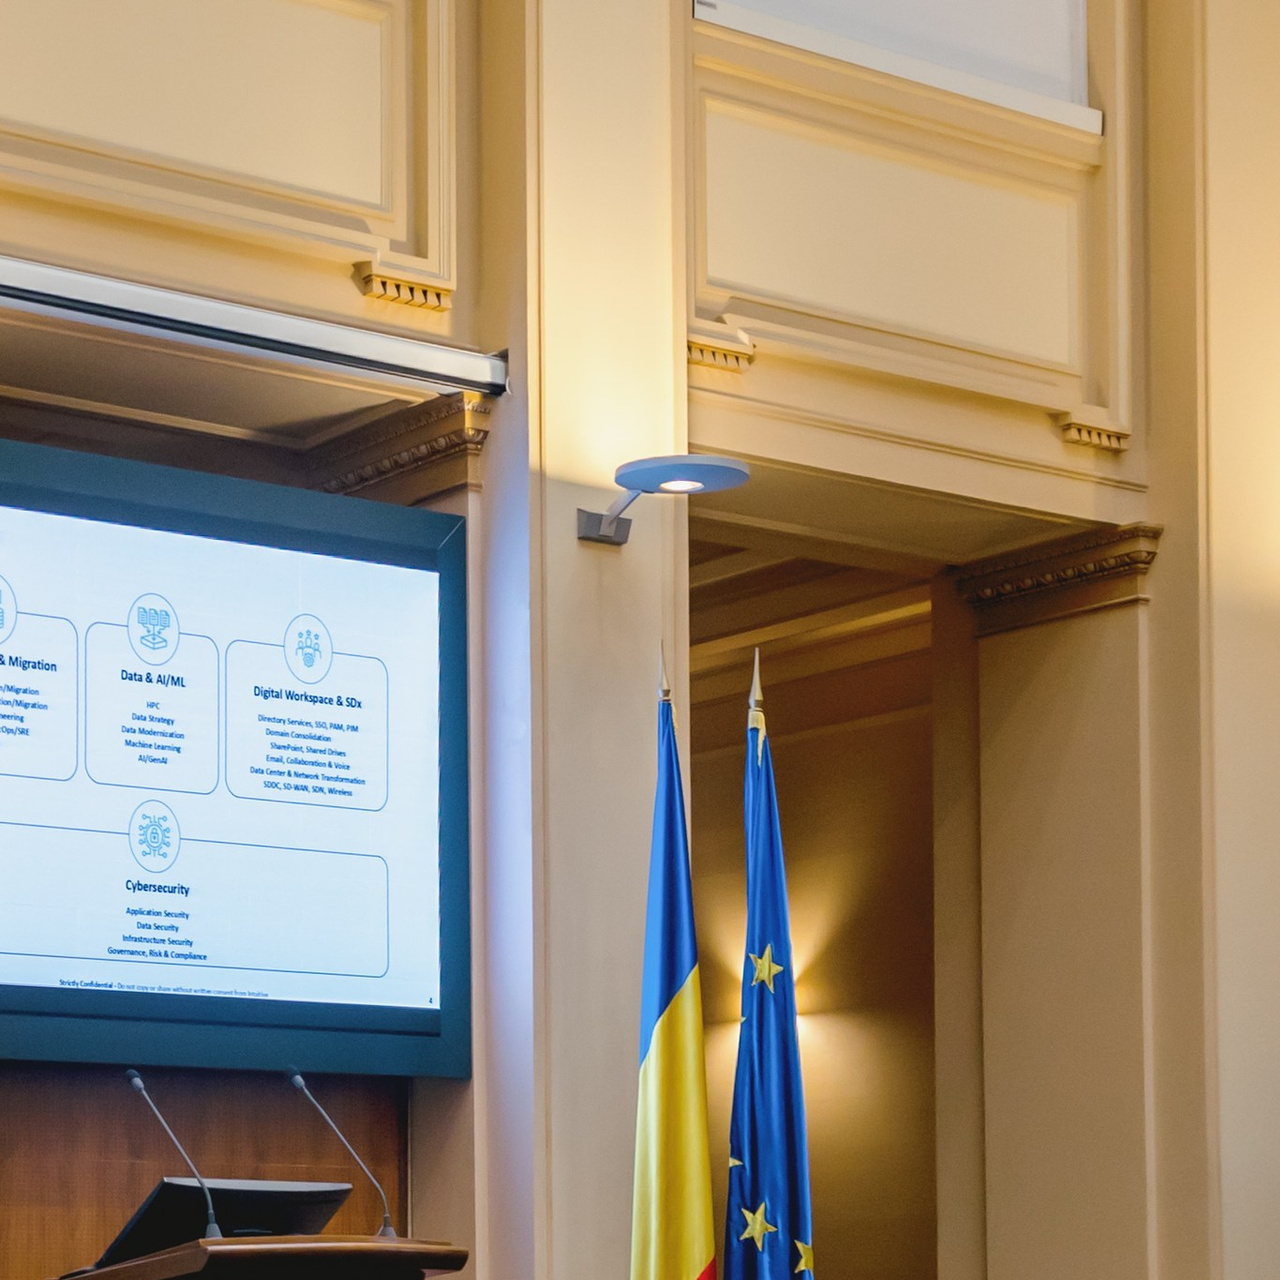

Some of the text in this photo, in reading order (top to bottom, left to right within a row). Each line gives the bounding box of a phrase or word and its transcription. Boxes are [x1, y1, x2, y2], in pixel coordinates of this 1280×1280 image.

[9, 656, 57, 672] Migration
[121, 669, 186, 687] Data & AI/ML
[254, 686, 362, 709] Digital Workspace & SDx
[146, 702, 160, 710] HPC
[132, 713, 174, 726] Data Strategy
[121, 725, 185, 739] Data Modernization
[266, 728, 331, 742] Domain Consolidation
[125, 739, 182, 754] Machine Learning
[270, 742, 346, 757] SharePoint, Shared Drives
[266, 755, 285, 764] Email,
[287, 757, 326, 768] Collaboration
[334, 762, 350, 770] Voice
[250, 766, 366, 785] Data Center & Network Transformation
[126, 880, 190, 897] Cybersecurity
[126, 907, 189, 920] Application Security
[137, 922, 179, 933] Data Security
[122, 934, 193, 947] Infrastructure Security
[164, 950, 169, 958] &
[171, 951, 207, 960] Compliance
